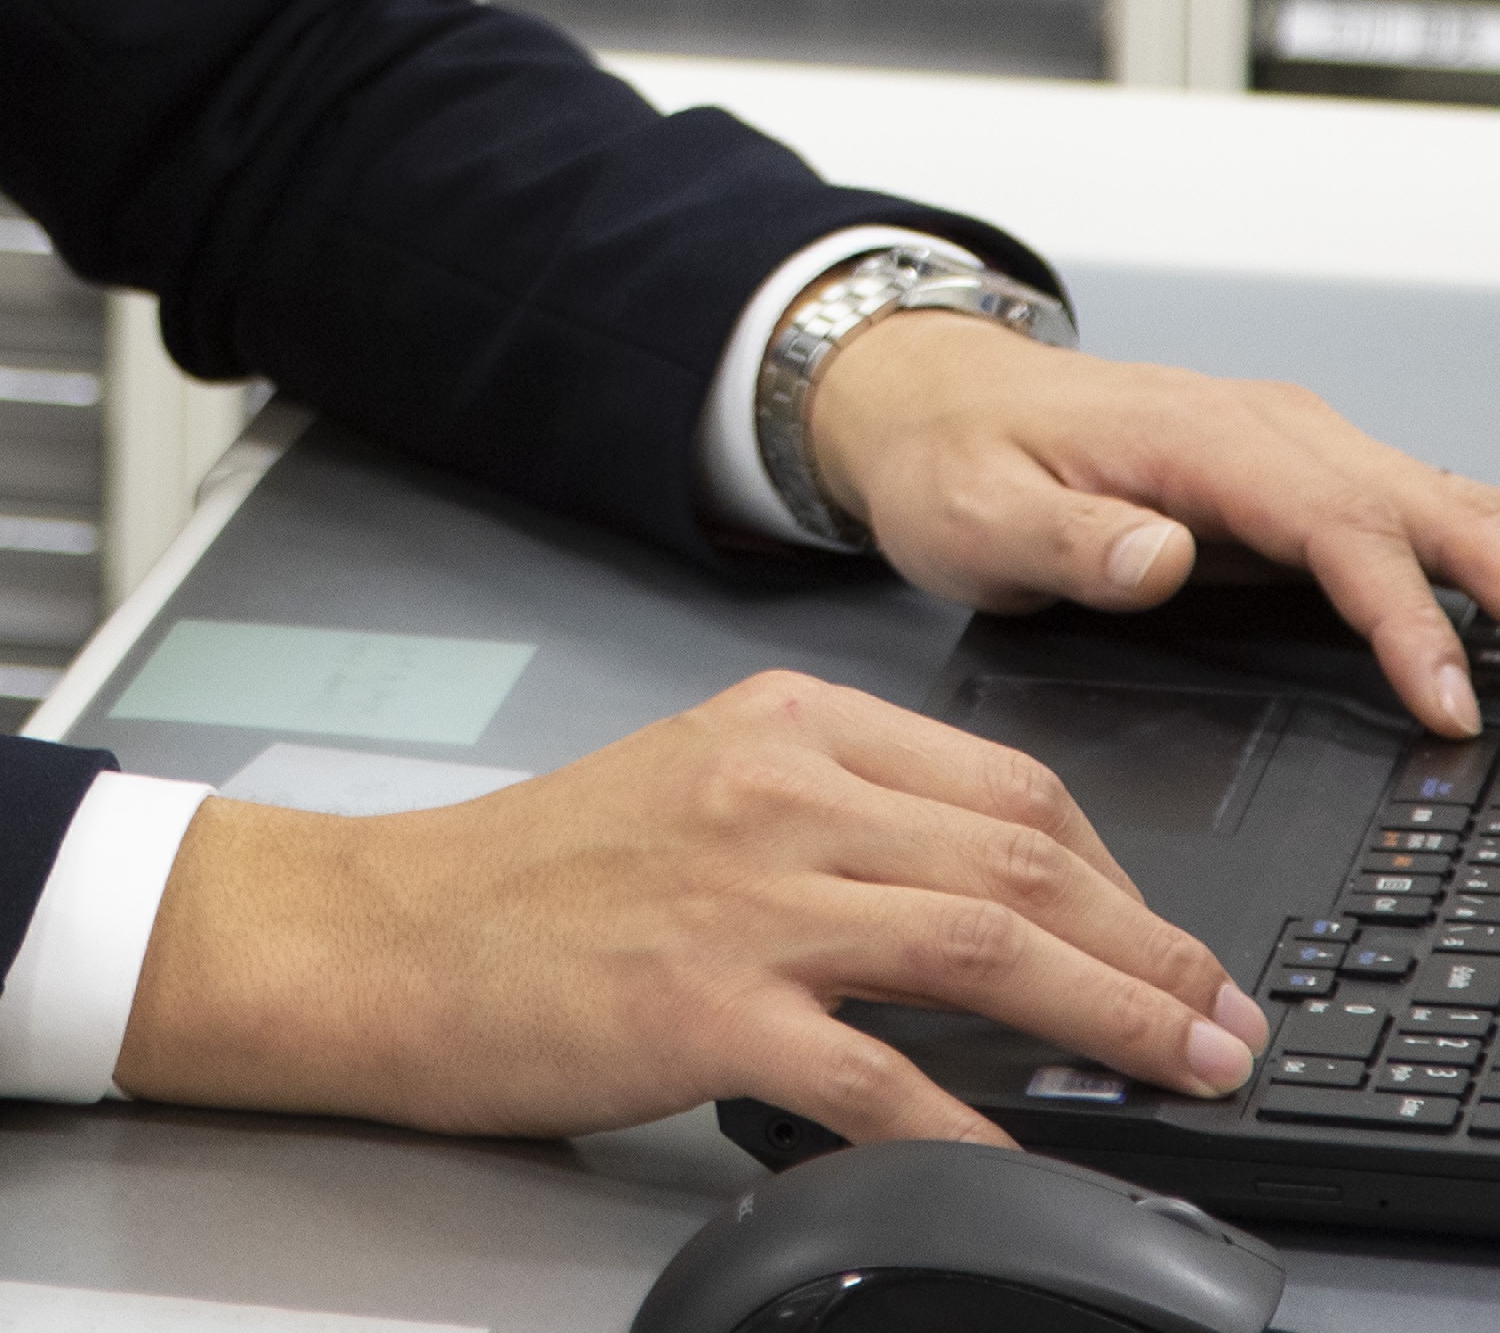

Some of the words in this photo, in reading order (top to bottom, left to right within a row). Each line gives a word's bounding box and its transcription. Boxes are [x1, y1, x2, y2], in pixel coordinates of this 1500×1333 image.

[1345, 1005, 1375, 1014] 0
[1437, 1039, 1469, 1048] 2
[1426, 1069, 1457, 1078] 3
